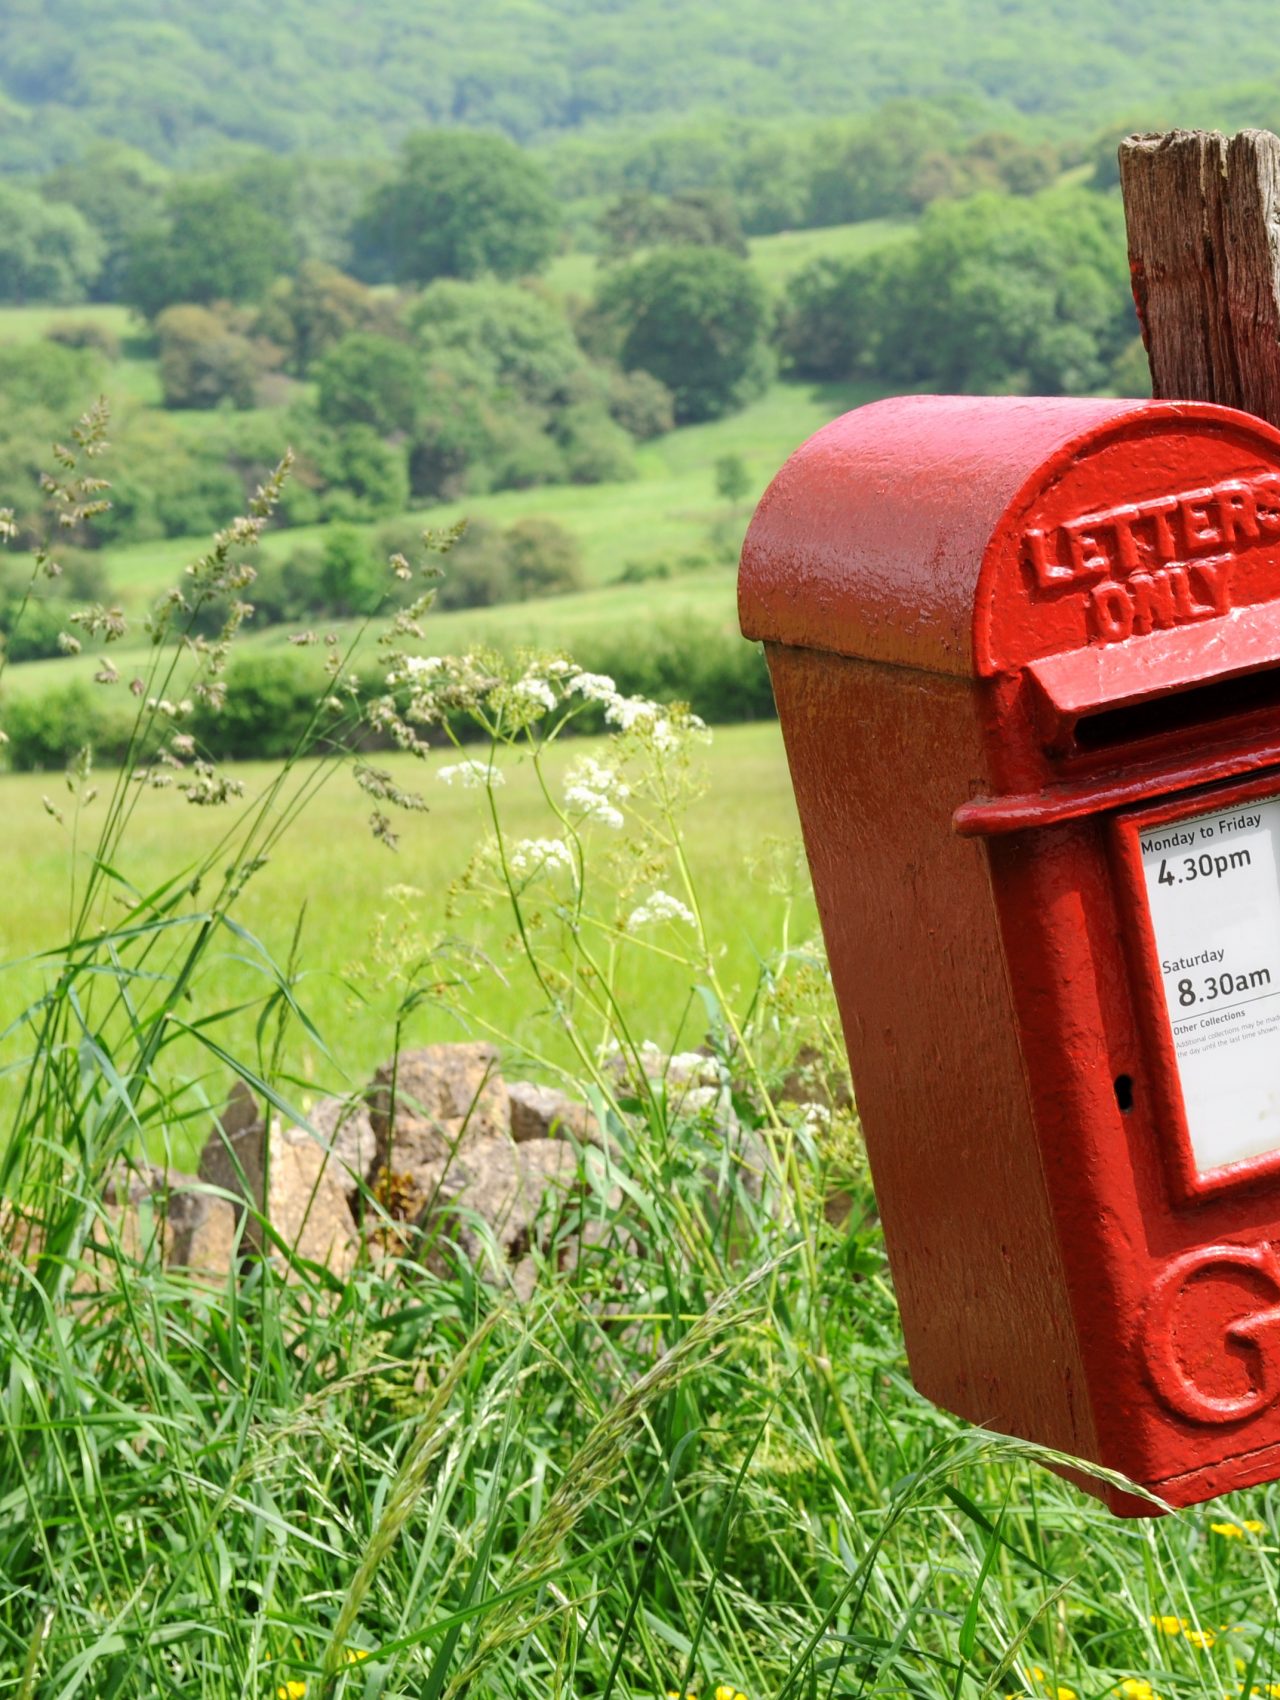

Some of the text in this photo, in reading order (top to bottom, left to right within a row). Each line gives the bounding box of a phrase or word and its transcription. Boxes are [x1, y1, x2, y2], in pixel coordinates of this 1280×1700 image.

[1090, 553, 1233, 643] ONLY
[1141, 814, 1262, 855] Monday to Friday
[1157, 849, 1251, 887] 4.30pm
[1162, 948, 1225, 974] Saturday
[1178, 967, 1271, 1007] 8.30am
[1173, 1009, 1246, 1036] Other Collections
[1176, 1036, 1207, 1049] Additional
[1207, 1026, 1240, 1041] collections
[1241, 1022, 1255, 1032] may
[1256, 1019, 1264, 1027] be
[1189, 1047, 1201, 1055] day
[1217, 1039, 1228, 1048] the
[1229, 1035, 1241, 1044] last
[1242, 1032, 1256, 1041] time
